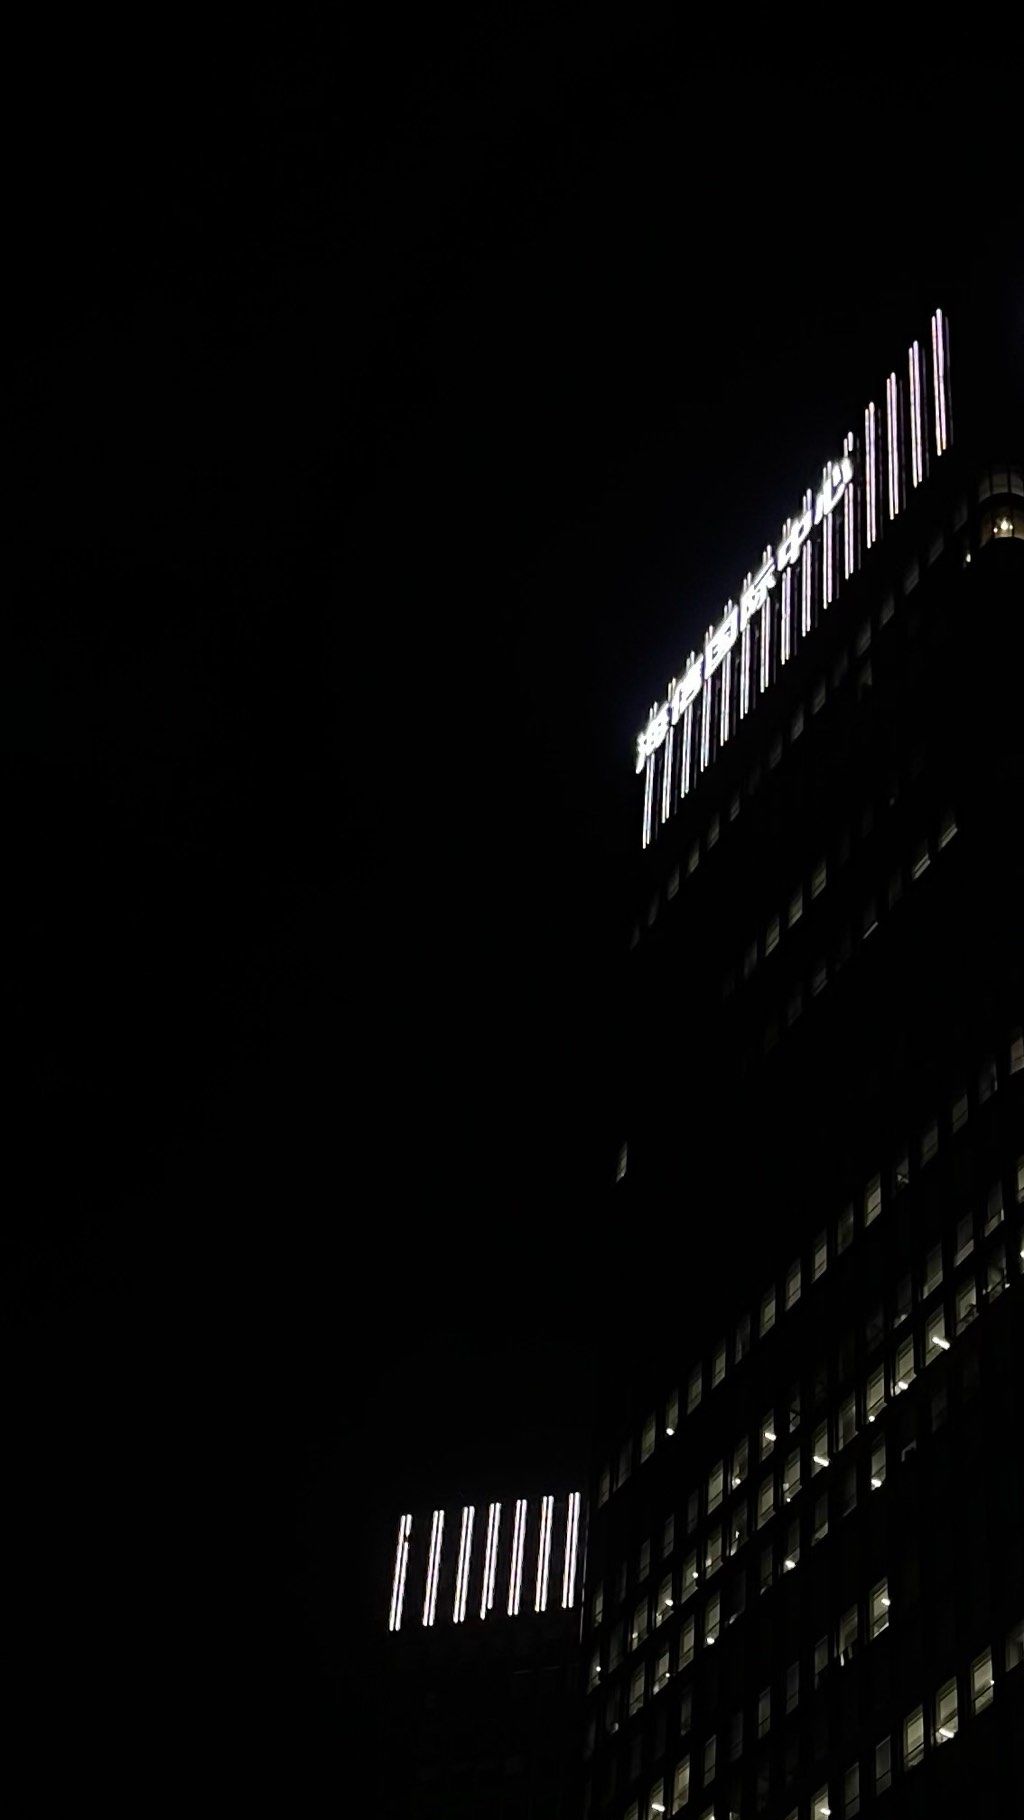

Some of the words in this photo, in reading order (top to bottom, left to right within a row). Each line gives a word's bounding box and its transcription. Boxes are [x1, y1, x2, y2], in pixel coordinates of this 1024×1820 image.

[635, 458, 854, 774] 海信国际中心
